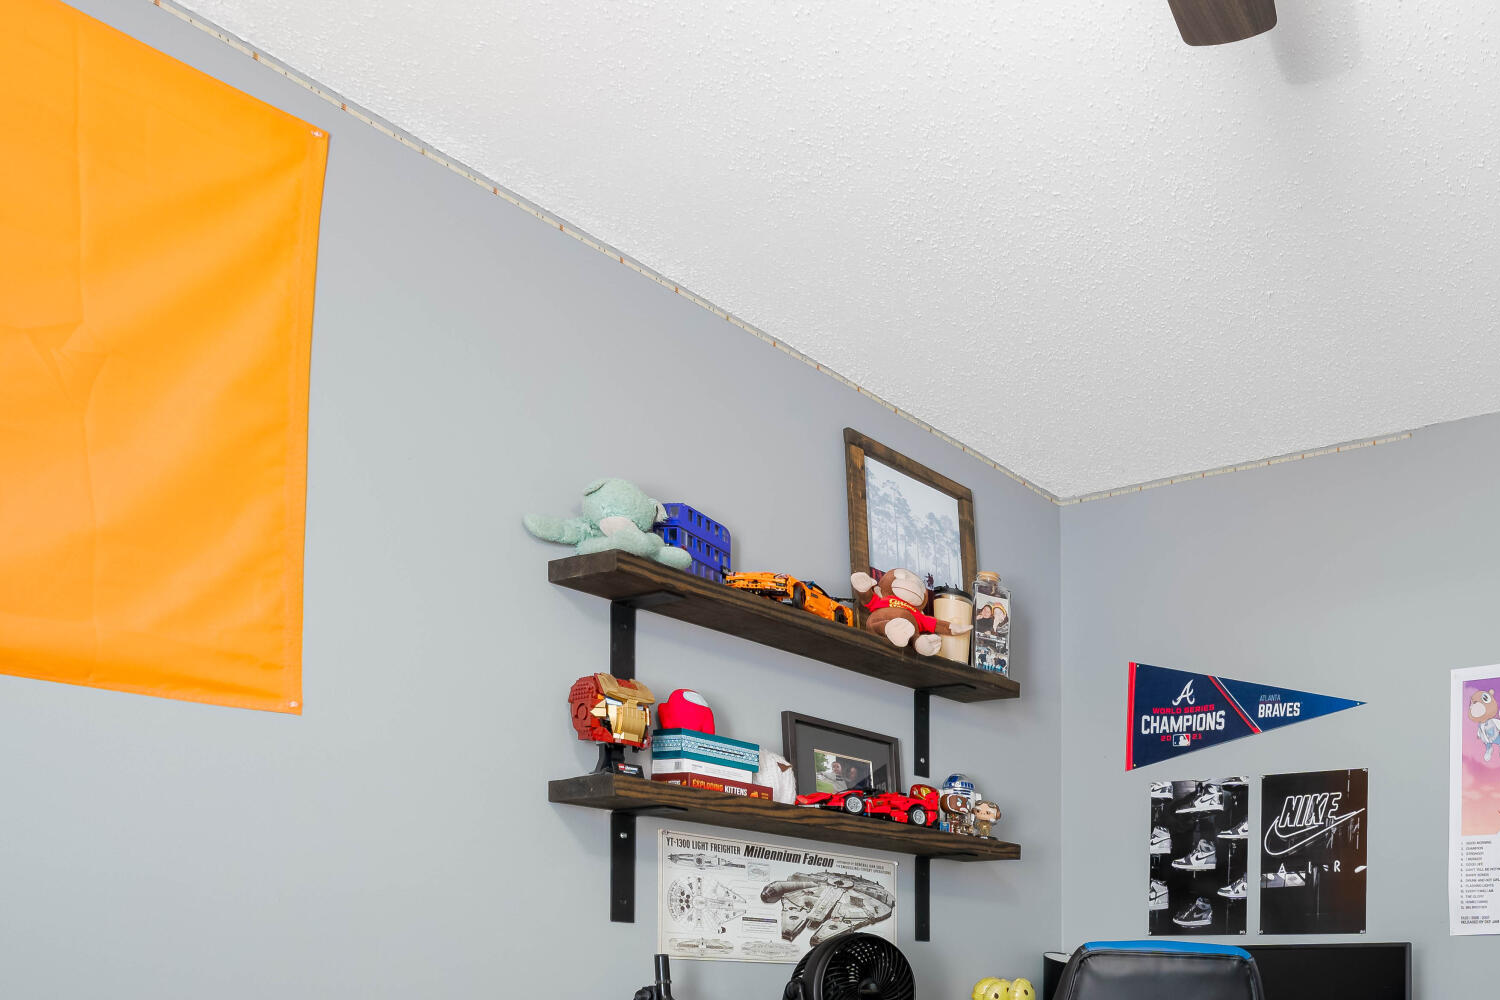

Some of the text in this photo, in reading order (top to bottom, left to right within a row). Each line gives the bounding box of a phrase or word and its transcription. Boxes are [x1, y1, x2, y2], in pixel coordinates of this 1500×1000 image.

[1152, 704, 1215, 715] WORLD SERIES
[1258, 702, 1301, 718] BRAVES
[1141, 710, 1226, 735] CHAMPIONS
[724, 785, 748, 797] KITTENS
[1278, 792, 1342, 828] NIKE
[666, 837, 691, 849] YT-1300
[692, 841, 709, 851] LIGHT
[710, 843, 741, 855] FREIGHTER
[743, 844, 802, 863] Millennium
[802, 853, 835, 868] Falcon
